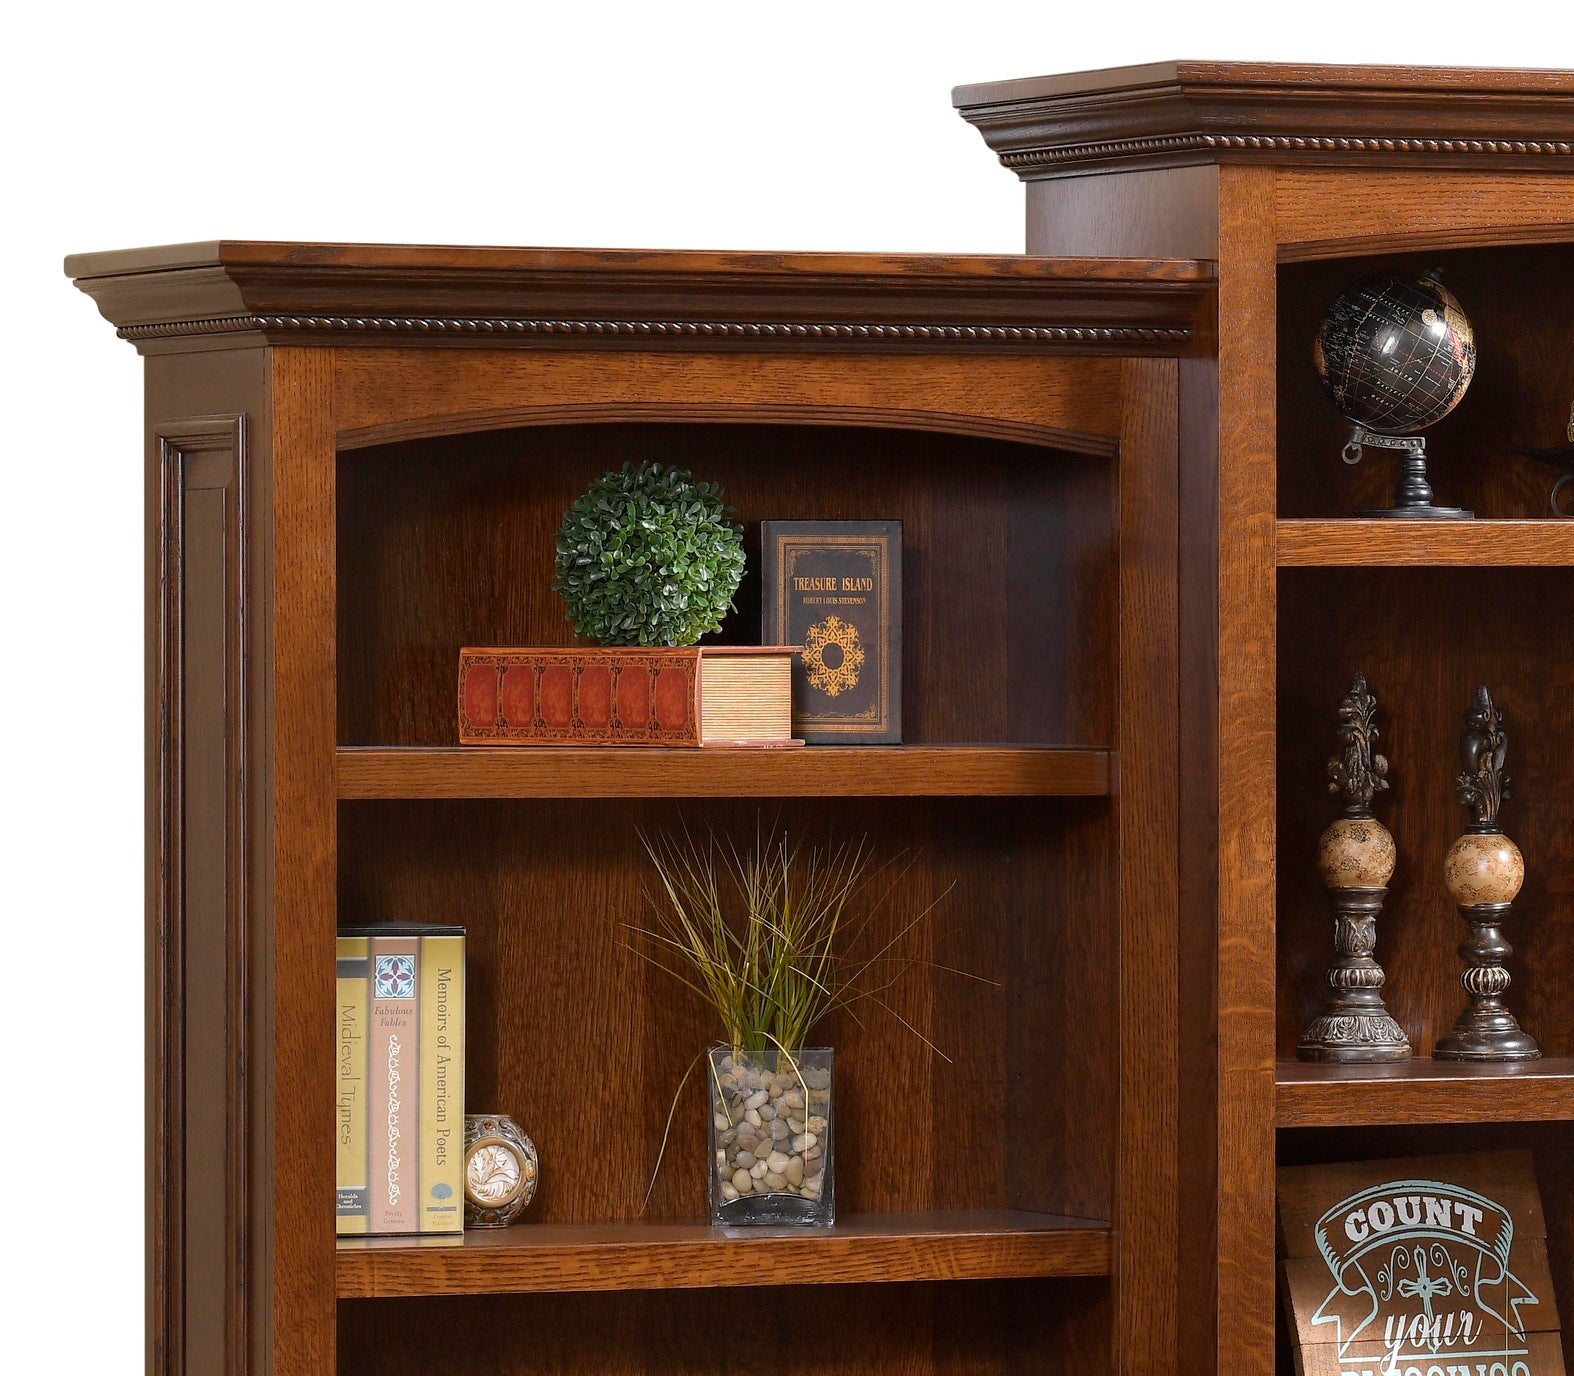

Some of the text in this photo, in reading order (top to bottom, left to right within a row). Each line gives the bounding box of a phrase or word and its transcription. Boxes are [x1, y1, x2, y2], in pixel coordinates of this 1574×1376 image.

[793, 577, 873, 591] TREASURE ISLAND
[374, 1006, 414, 1015] Fabulous
[380, 1017, 407, 1027] Fables
[341, 1005, 361, 1080] Midieval
[436, 968, 451, 1166] Memoirs of American Poets
[1345, 1196, 1483, 1242] COUNT
[1380, 1310, 1483, 1376] your
